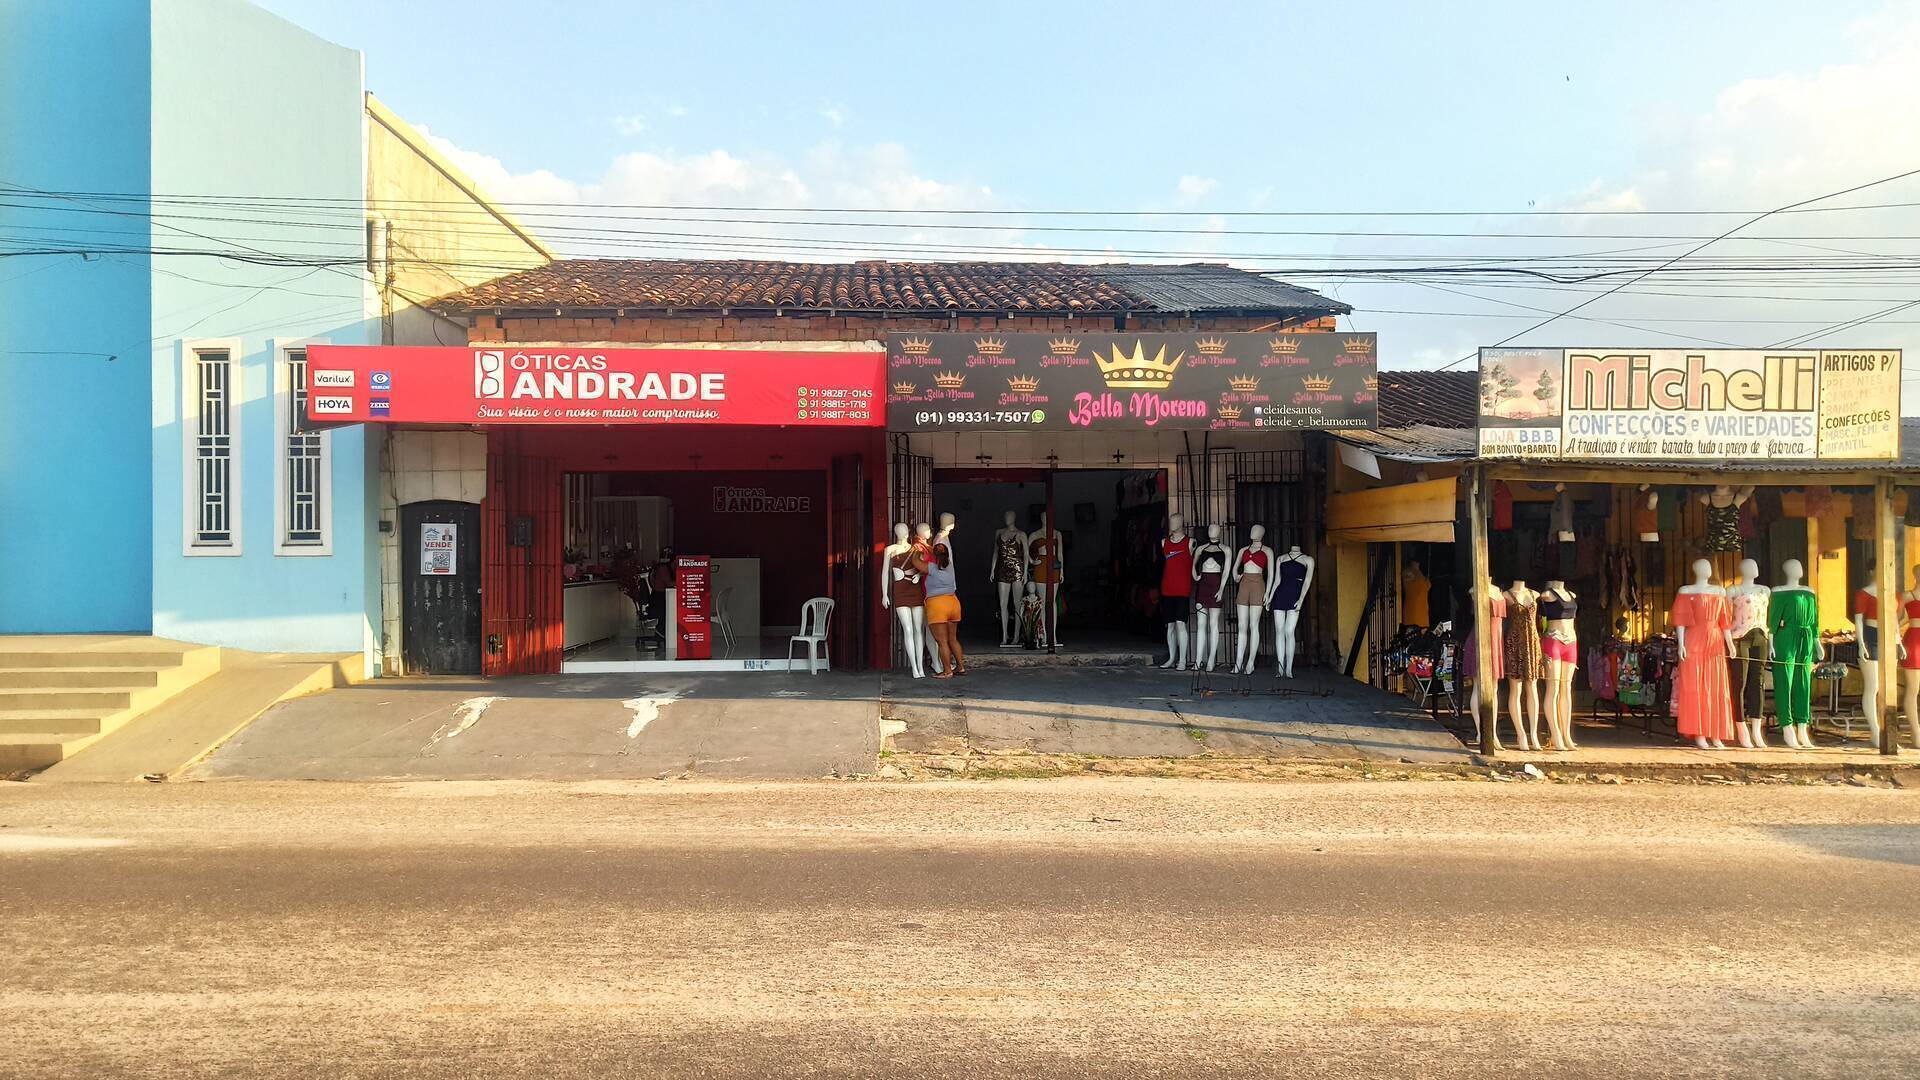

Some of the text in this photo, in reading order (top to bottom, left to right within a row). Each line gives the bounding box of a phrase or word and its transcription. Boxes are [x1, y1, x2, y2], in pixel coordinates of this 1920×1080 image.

[510, 352, 607, 370] ÓTICAS
[1823, 353, 1896, 371] ARTIGOS P/
[510, 371, 725, 400] ANDRADE
[1568, 354, 1816, 411] Michelli
[809, 389, 873, 398] 91 98287-0145
[318, 399, 351, 409] HOYA
[809, 399, 867, 408] 91 98815-1718
[1068, 392, 1207, 426] Bella Morena
[1263, 404, 1322, 415] cleidesantos
[477, 404, 721, 421] Sua visão é o nosso maior compromisso.
[809, 410, 870, 419] 91 98817-8031
[915, 411, 1030, 425] (91) 99331-7507
[1826, 409, 1891, 429] CONFECÇÕES
[1263, 416, 1367, 427] cleide_e_belamorena
[1568, 411, 1814, 438] CONFECÇÕES e VARIEDADES
[1482, 430, 1515, 444] LOJA
[1481, 444, 1496, 455] BOM
[1497, 444, 1522, 454] BONITO
[1527, 444, 1557, 454] BARATO
[1566, 438, 1576, 453] A
[1578, 438, 1618, 456] tradição
[1628, 439, 1657, 454] vender
[1698, 440, 1716, 454] tudo
[1718, 441, 1723, 454] a
[1726, 440, 1748, 457] preço
[1751, 440, 1760, 454] de
[727, 486, 766, 498] ÓTICAS
[727, 497, 811, 513] ANDRADE
